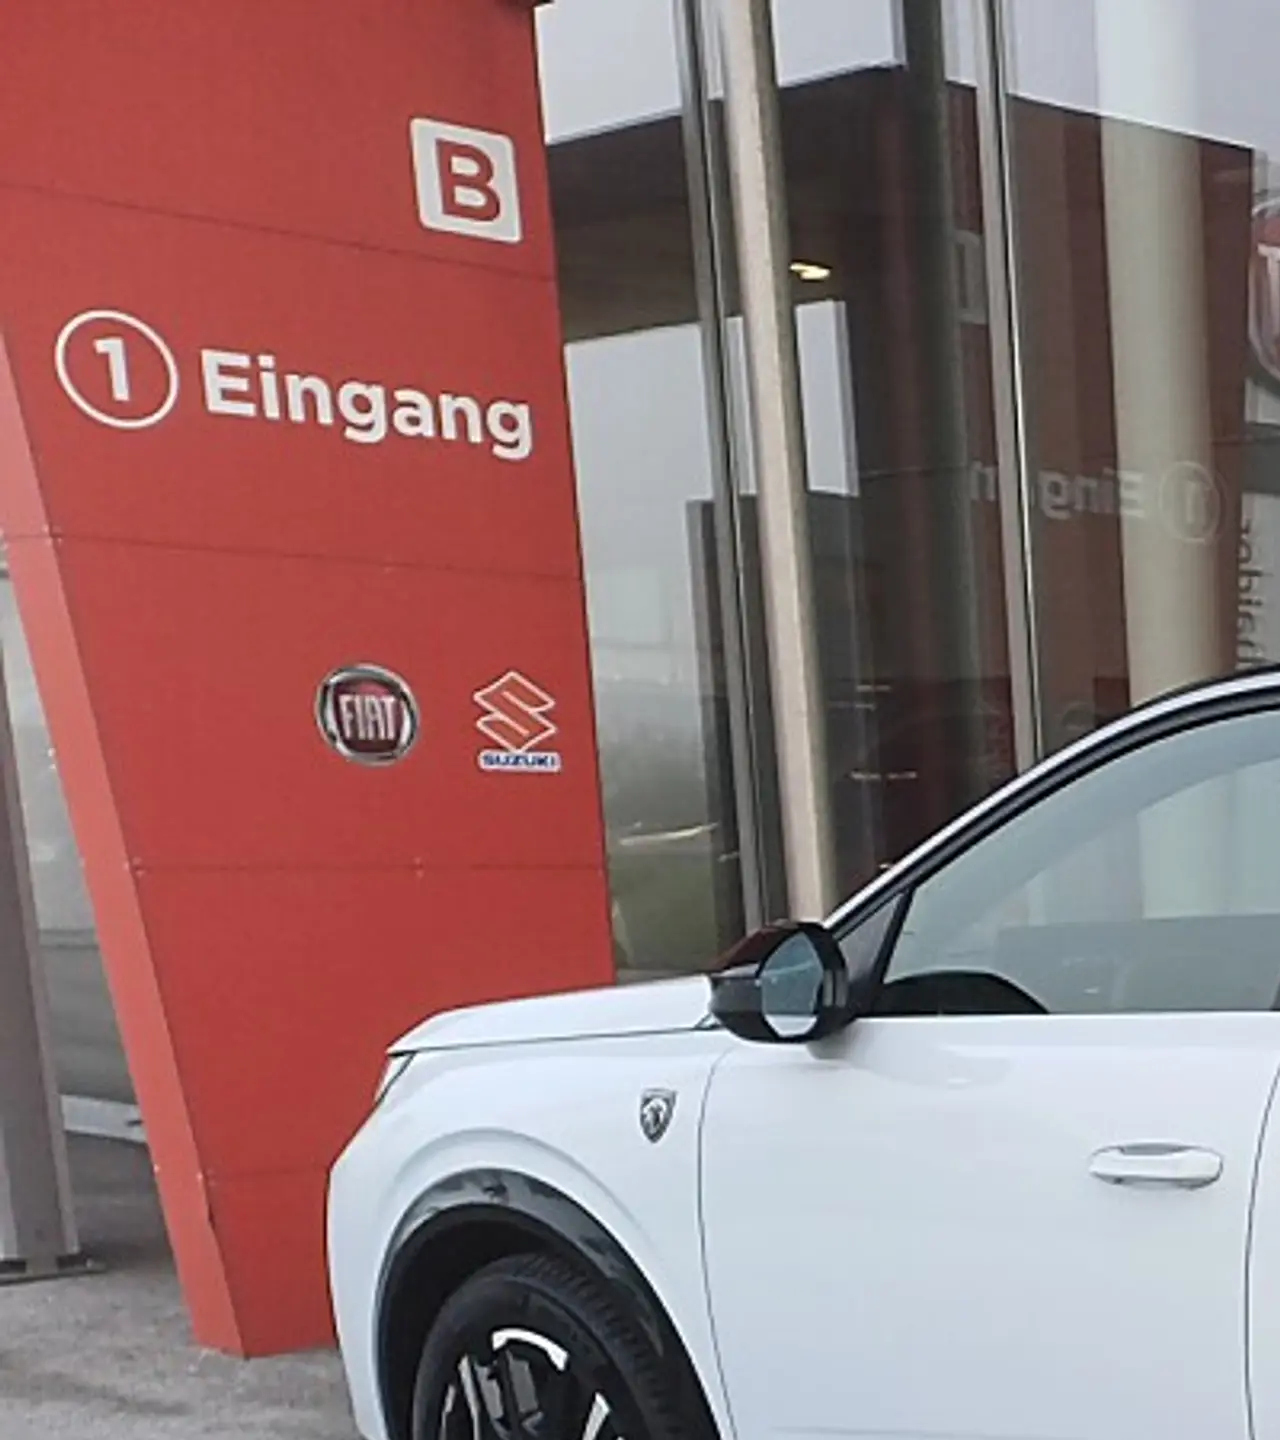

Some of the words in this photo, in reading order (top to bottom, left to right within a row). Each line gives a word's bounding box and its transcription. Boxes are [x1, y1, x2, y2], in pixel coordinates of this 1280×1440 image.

[434, 138, 501, 223] B
[94, 337, 131, 402] 1
[201, 348, 534, 460] Eingang
[337, 693, 397, 741] FIAT
